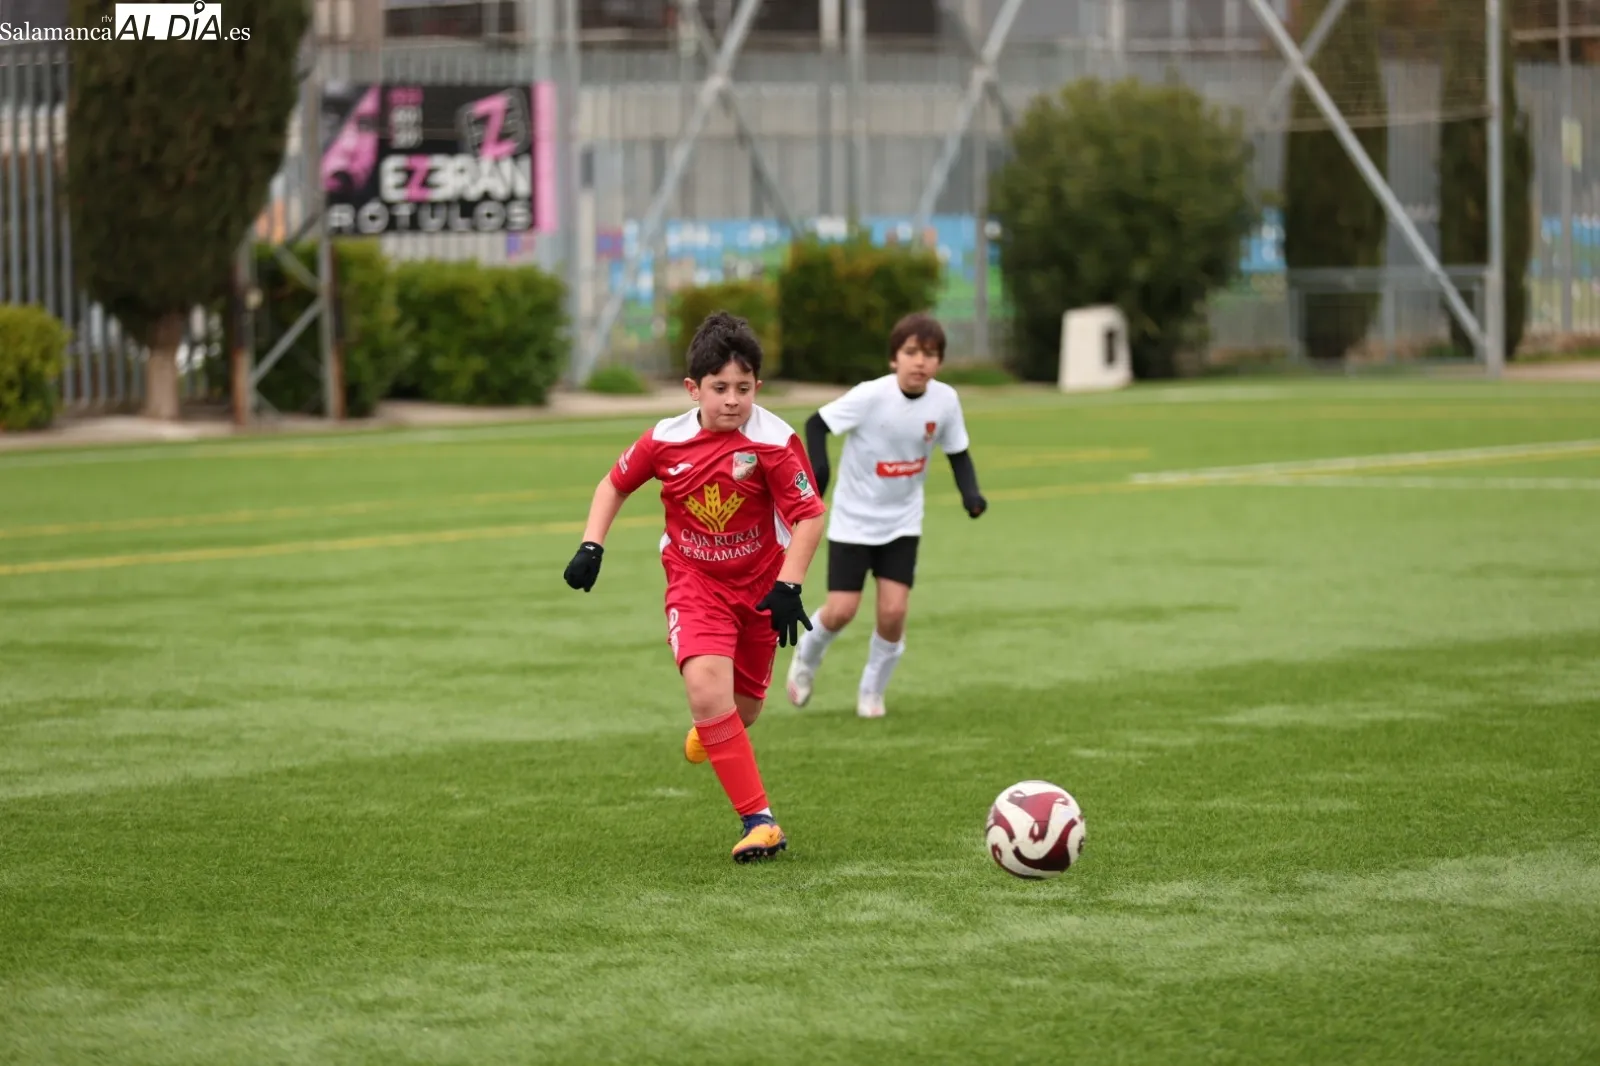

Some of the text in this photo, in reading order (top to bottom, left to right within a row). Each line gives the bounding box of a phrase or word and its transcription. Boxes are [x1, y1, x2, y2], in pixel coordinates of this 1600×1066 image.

[681, 525, 761, 549] CAJA RURAL
[679, 540, 762, 562] DE SALAMANCA
